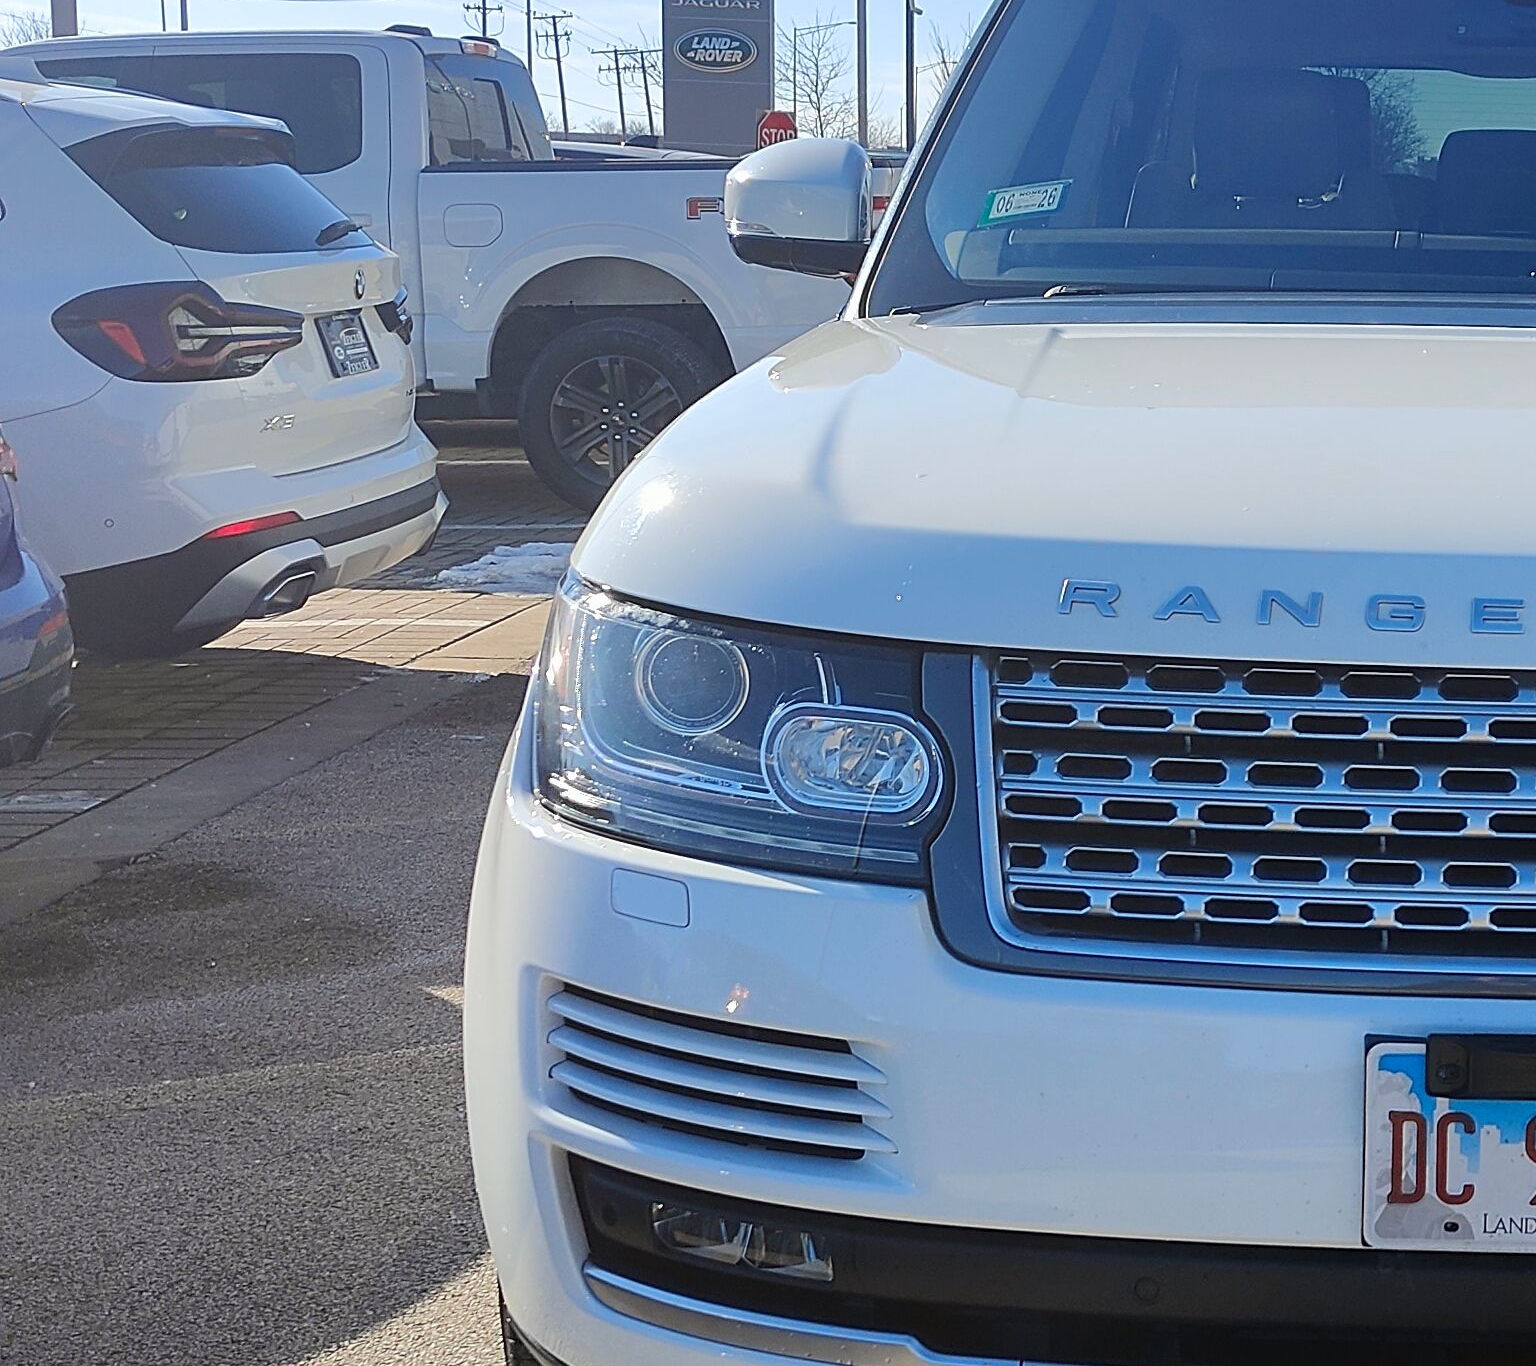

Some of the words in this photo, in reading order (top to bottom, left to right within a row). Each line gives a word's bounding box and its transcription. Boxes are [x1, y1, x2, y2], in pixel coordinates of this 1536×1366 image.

[691, 37, 731, 49] LAND
[694, 49, 743, 62] ROVER
[996, 193, 1015, 214] 06
[1037, 187, 1058, 208] 26
[260, 414, 296, 433] X3
[1058, 577, 1526, 634] RANGE
[1387, 1110, 1476, 1205] DC
